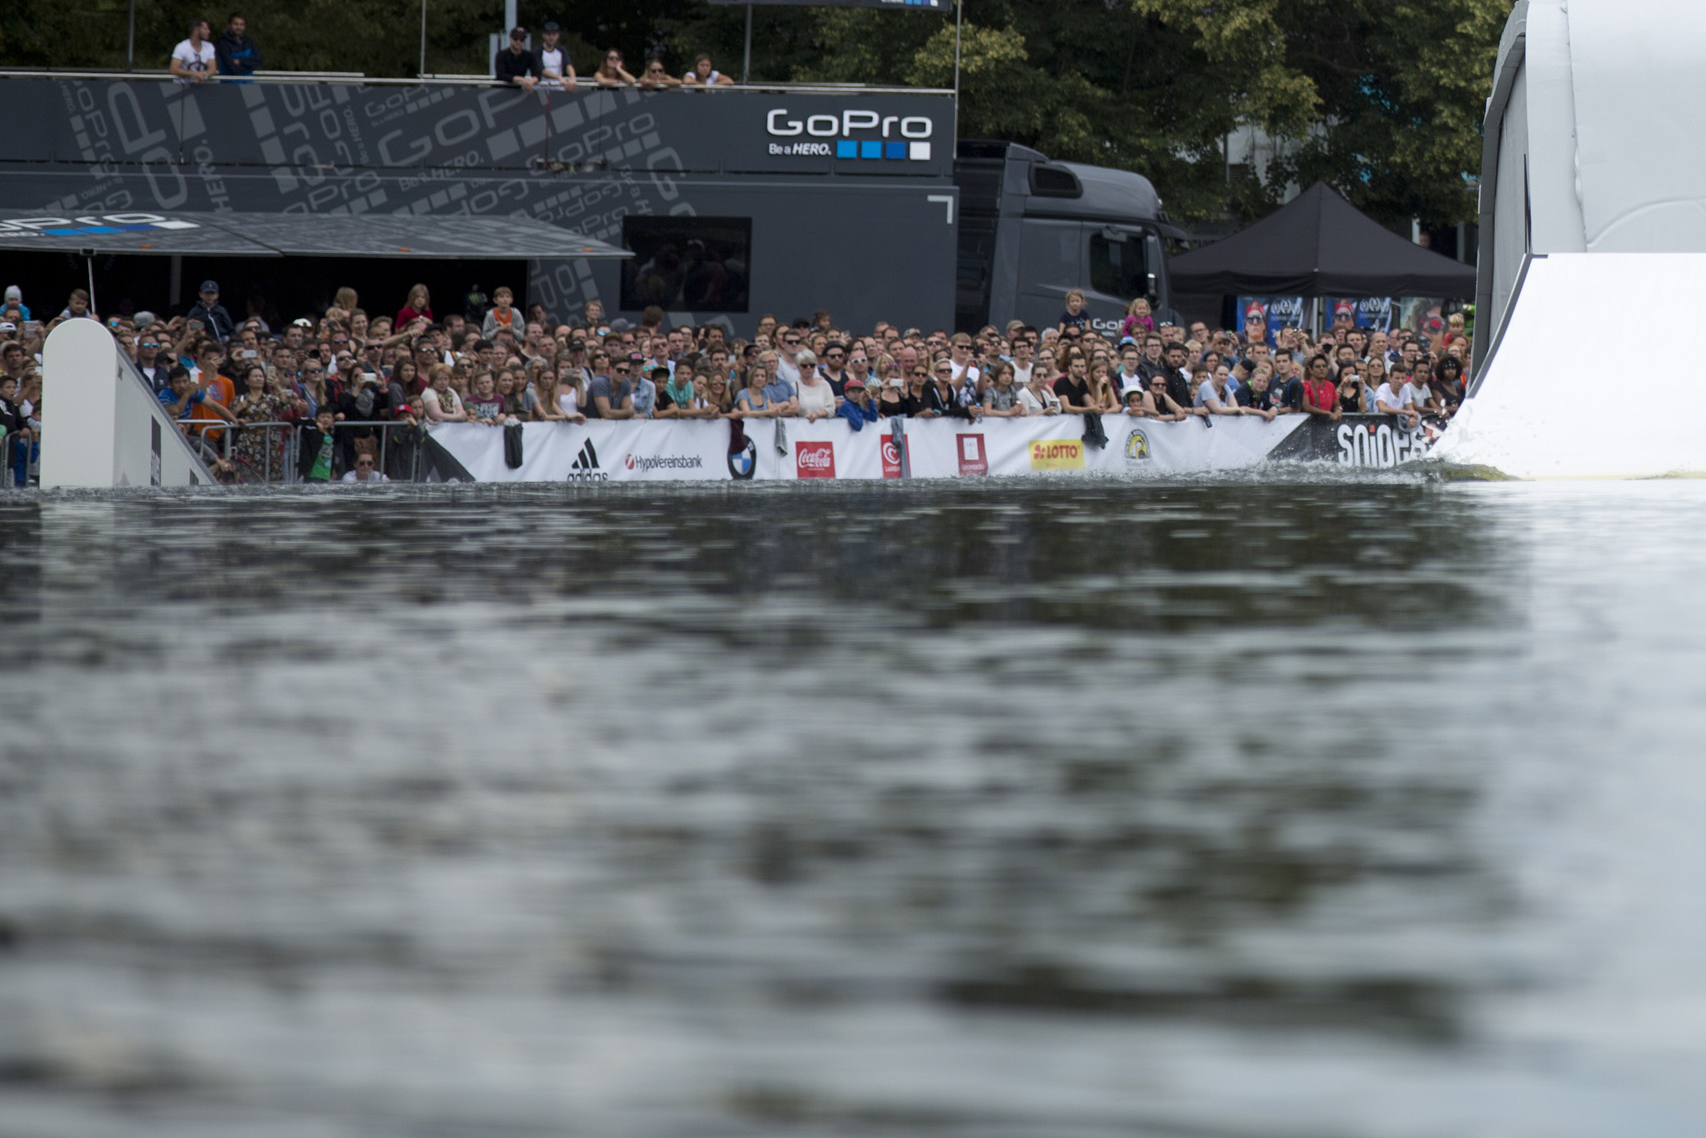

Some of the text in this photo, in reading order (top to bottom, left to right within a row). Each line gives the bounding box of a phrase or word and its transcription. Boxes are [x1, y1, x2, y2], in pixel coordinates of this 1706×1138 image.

[767, 108, 933, 139] GoPro
[768, 143, 832, 156] Be a HERO.
[1046, 445, 1078, 460] LOTTO
[635, 454, 703, 473] HypoVereinsbank
[567, 468, 609, 482] adidas
